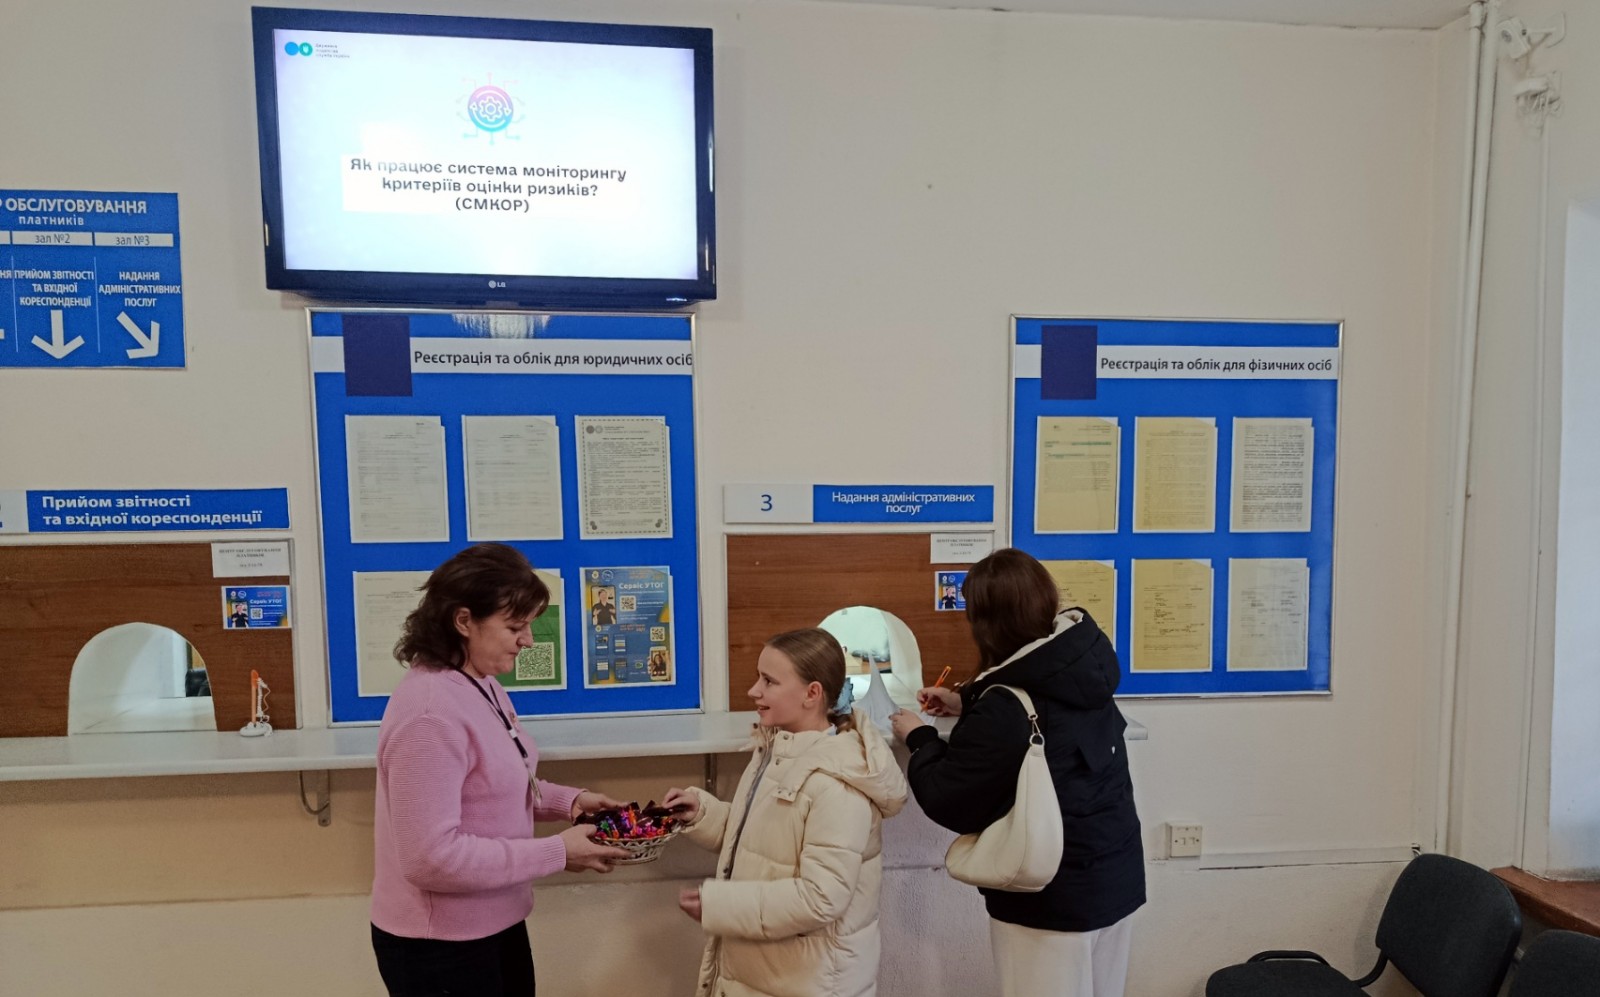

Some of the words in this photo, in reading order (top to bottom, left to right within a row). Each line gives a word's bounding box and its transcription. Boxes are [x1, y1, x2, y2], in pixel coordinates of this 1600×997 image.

[350, 158, 372, 171] Як
[377, 161, 443, 174] працює
[447, 164, 518, 176] система
[522, 165, 627, 182] моніторингу
[382, 177, 461, 193] критеріїв
[466, 180, 522, 195] оцінки
[527, 183, 598, 197] ризиків?
[5, 198, 147, 214] ОБСЛУГОВУВАННЯ
[455, 197, 530, 213] (СМКОР)
[19, 214, 84, 226] платників
[35, 235, 51, 243] зал
[53, 234, 70, 243] №2
[116, 236, 131, 245] зал
[134, 235, 150, 245] №3
[14, 269, 51, 279] ПРИЙОМ
[52, 270, 94, 280] ЗВІТНОСТІ
[119, 272, 160, 282] НАДАННЯ
[32, 284, 42, 292] ТА
[44, 282, 78, 294] ВХІДНОЇ
[99, 285, 181, 295] АДМІНІСТРАТИВНИХ
[20, 296, 92, 307] КОРЕСПОНДЕНЦІЇ
[124, 298, 157, 307] ПОСЛУГ
[414, 351, 491, 366] Реєстрація
[495, 354, 510, 364] та
[513, 351, 552, 366] облік
[554, 355, 579, 367] для
[583, 355, 662, 367] юридичних
[666, 353, 692, 366] осіб
[1100, 357, 1169, 371] Реєстрація
[1171, 360, 1184, 370] та
[1187, 357, 1220, 370] облік
[1223, 361, 1246, 371] для
[1248, 358, 1305, 372] фізичних
[1307, 358, 1332, 371] осіб
[42, 495, 112, 509] Прийом
[115, 495, 191, 508] звітності
[760, 494, 773, 512] 3
[832, 491, 880, 503] Надання
[881, 491, 975, 504] адміністративних
[885, 504, 923, 515] послуг
[43, 515, 61, 525] та
[66, 512, 128, 526] вхідної
[131, 510, 263, 525] кореспонденції
